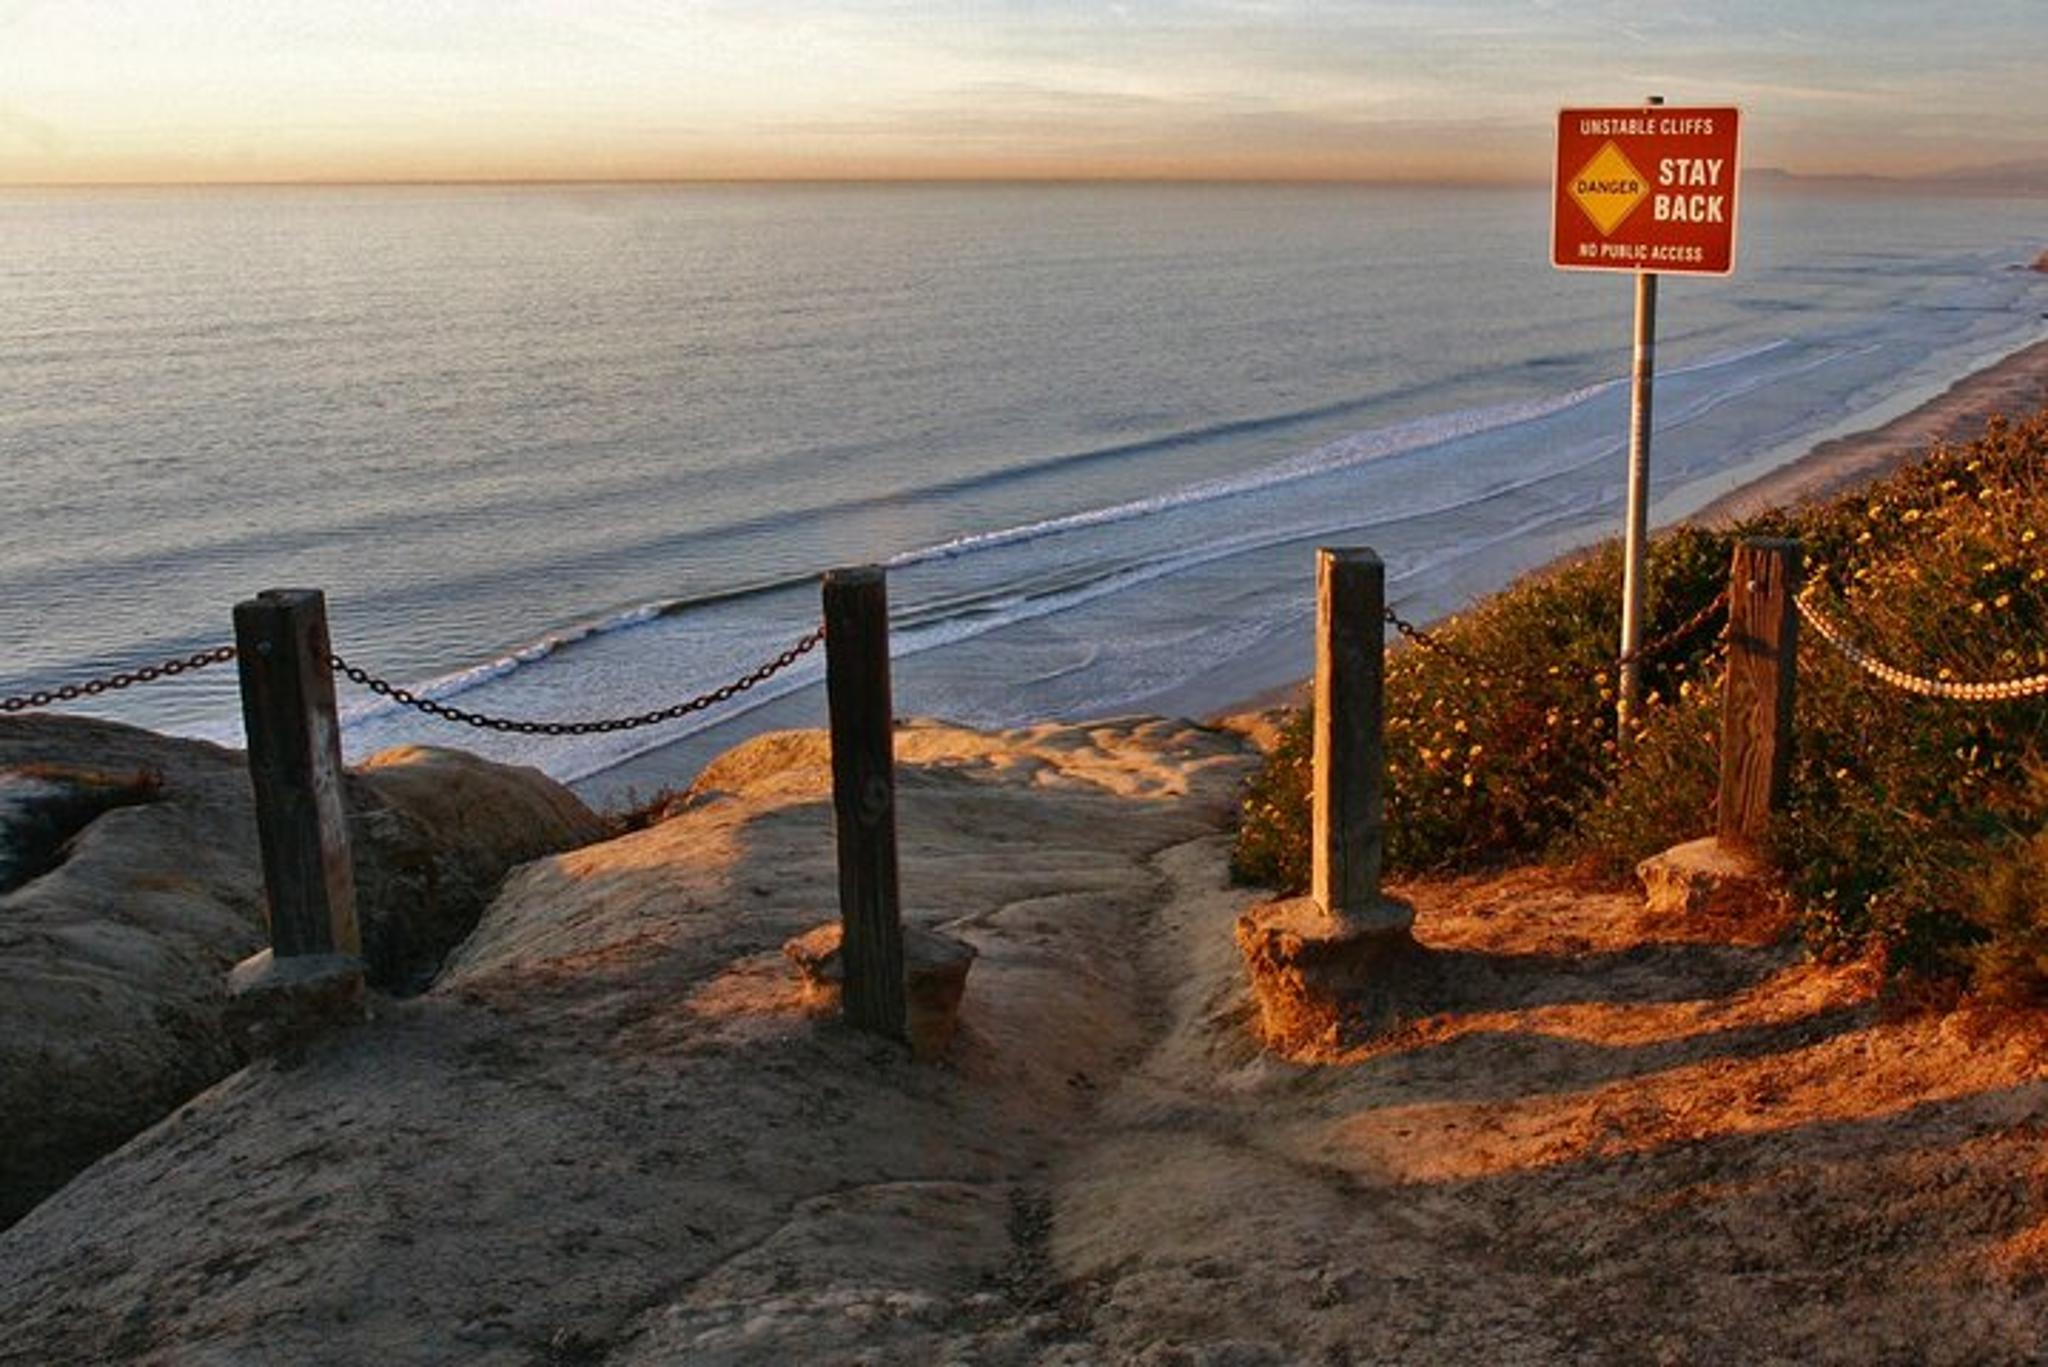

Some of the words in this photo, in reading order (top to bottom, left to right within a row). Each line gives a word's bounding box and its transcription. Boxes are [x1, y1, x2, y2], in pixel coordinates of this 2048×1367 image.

[1580, 119, 1655, 135] UNSTABLE
[1660, 119, 1713, 135] CLIFFS
[1659, 158, 1723, 186] STAY
[1577, 180, 1639, 195] DANGER
[1654, 195, 1723, 222] BACK
[1578, 244, 1598, 257] NO
[1601, 244, 1647, 260] PUBLIC
[1652, 246, 1703, 262] ACCESS
